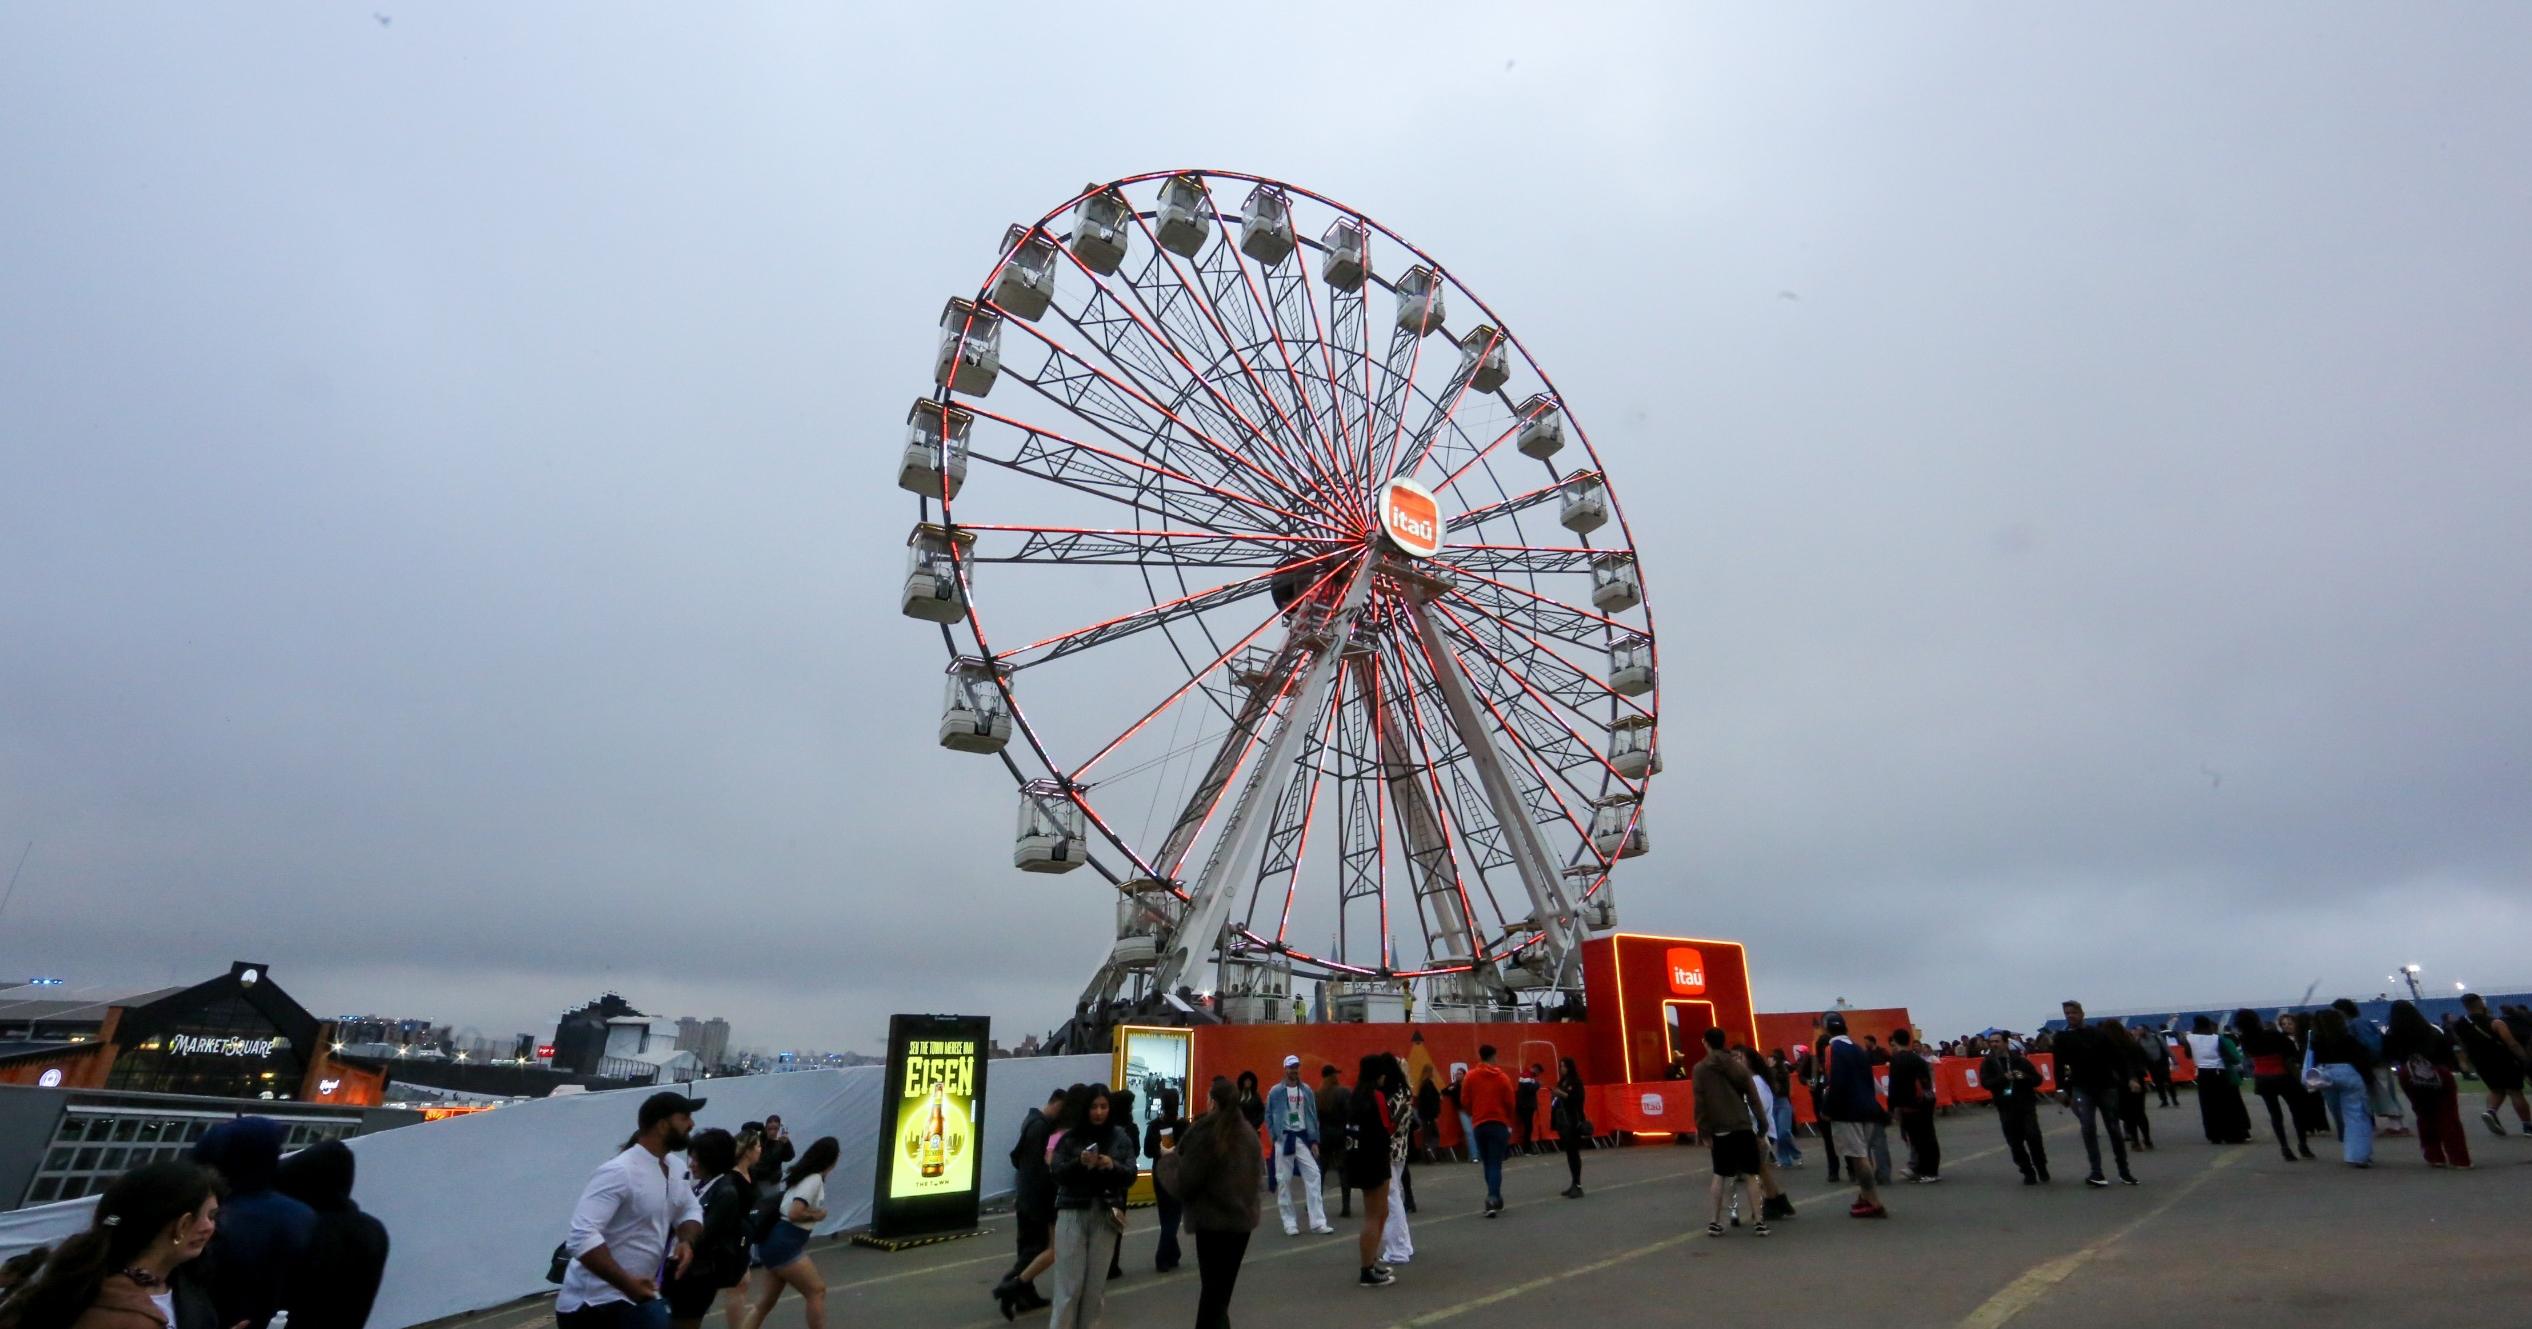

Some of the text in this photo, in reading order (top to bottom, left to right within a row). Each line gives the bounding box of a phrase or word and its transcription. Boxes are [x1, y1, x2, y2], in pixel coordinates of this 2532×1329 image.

[1392, 506, 1433, 542] itaú
[1674, 966, 1703, 986] itaú
[920, 1041, 930, 1055] THE
[904, 1056, 975, 1098] EISEN
